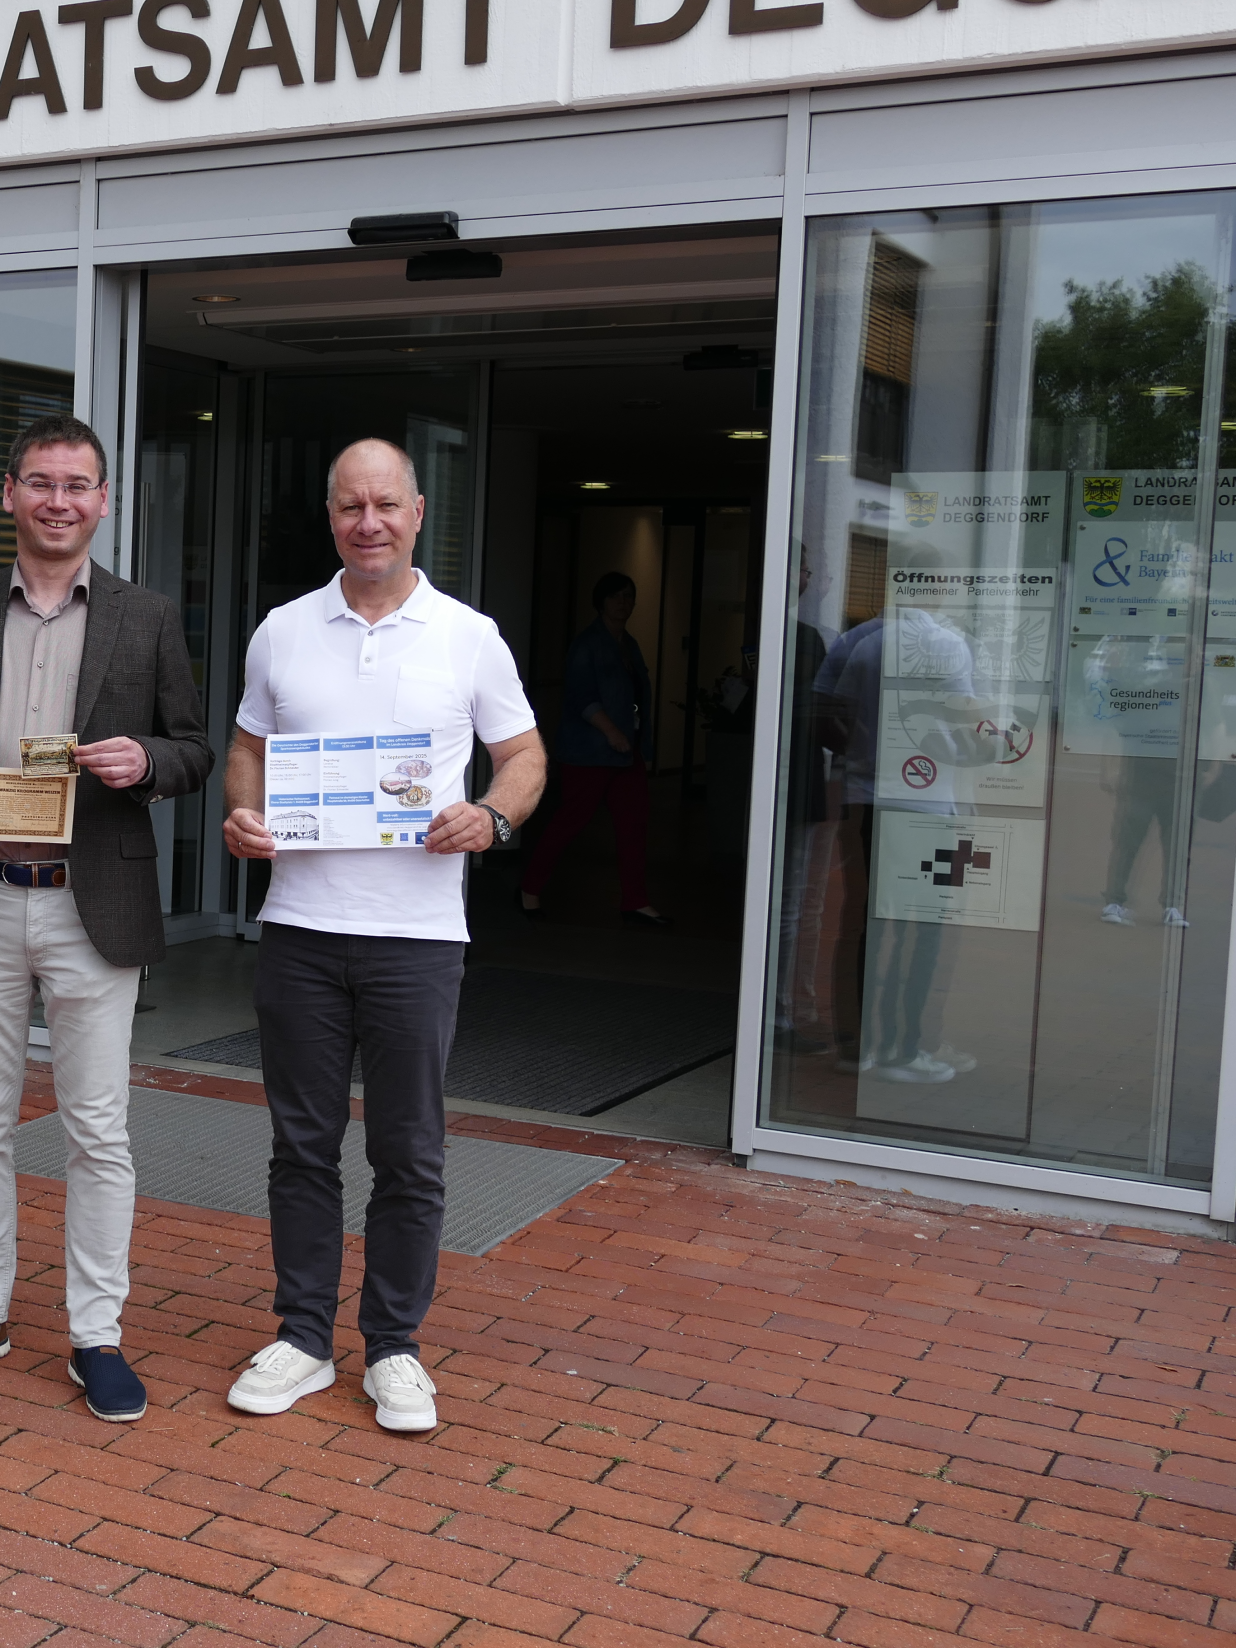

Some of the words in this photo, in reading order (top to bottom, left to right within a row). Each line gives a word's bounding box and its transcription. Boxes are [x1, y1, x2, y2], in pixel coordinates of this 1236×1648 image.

[943, 494, 1051, 507] LANDRATSAMT
[942, 511, 1050, 523] DEGGENDORF
[892, 570, 1053, 586] Öffnungszeiten
[1138, 566, 1186, 582] Bayern
[896, 586, 959, 598] Allgemeiner
[967, 586, 1040, 597] Parteiverkehr
[1085, 595, 1098, 604] Für
[1099, 596, 1115, 604] eine
[1109, 688, 1180, 700] Gesundheits
[978, 782, 1001, 790] draußen
[1002, 783, 1024, 791] bleiben!
